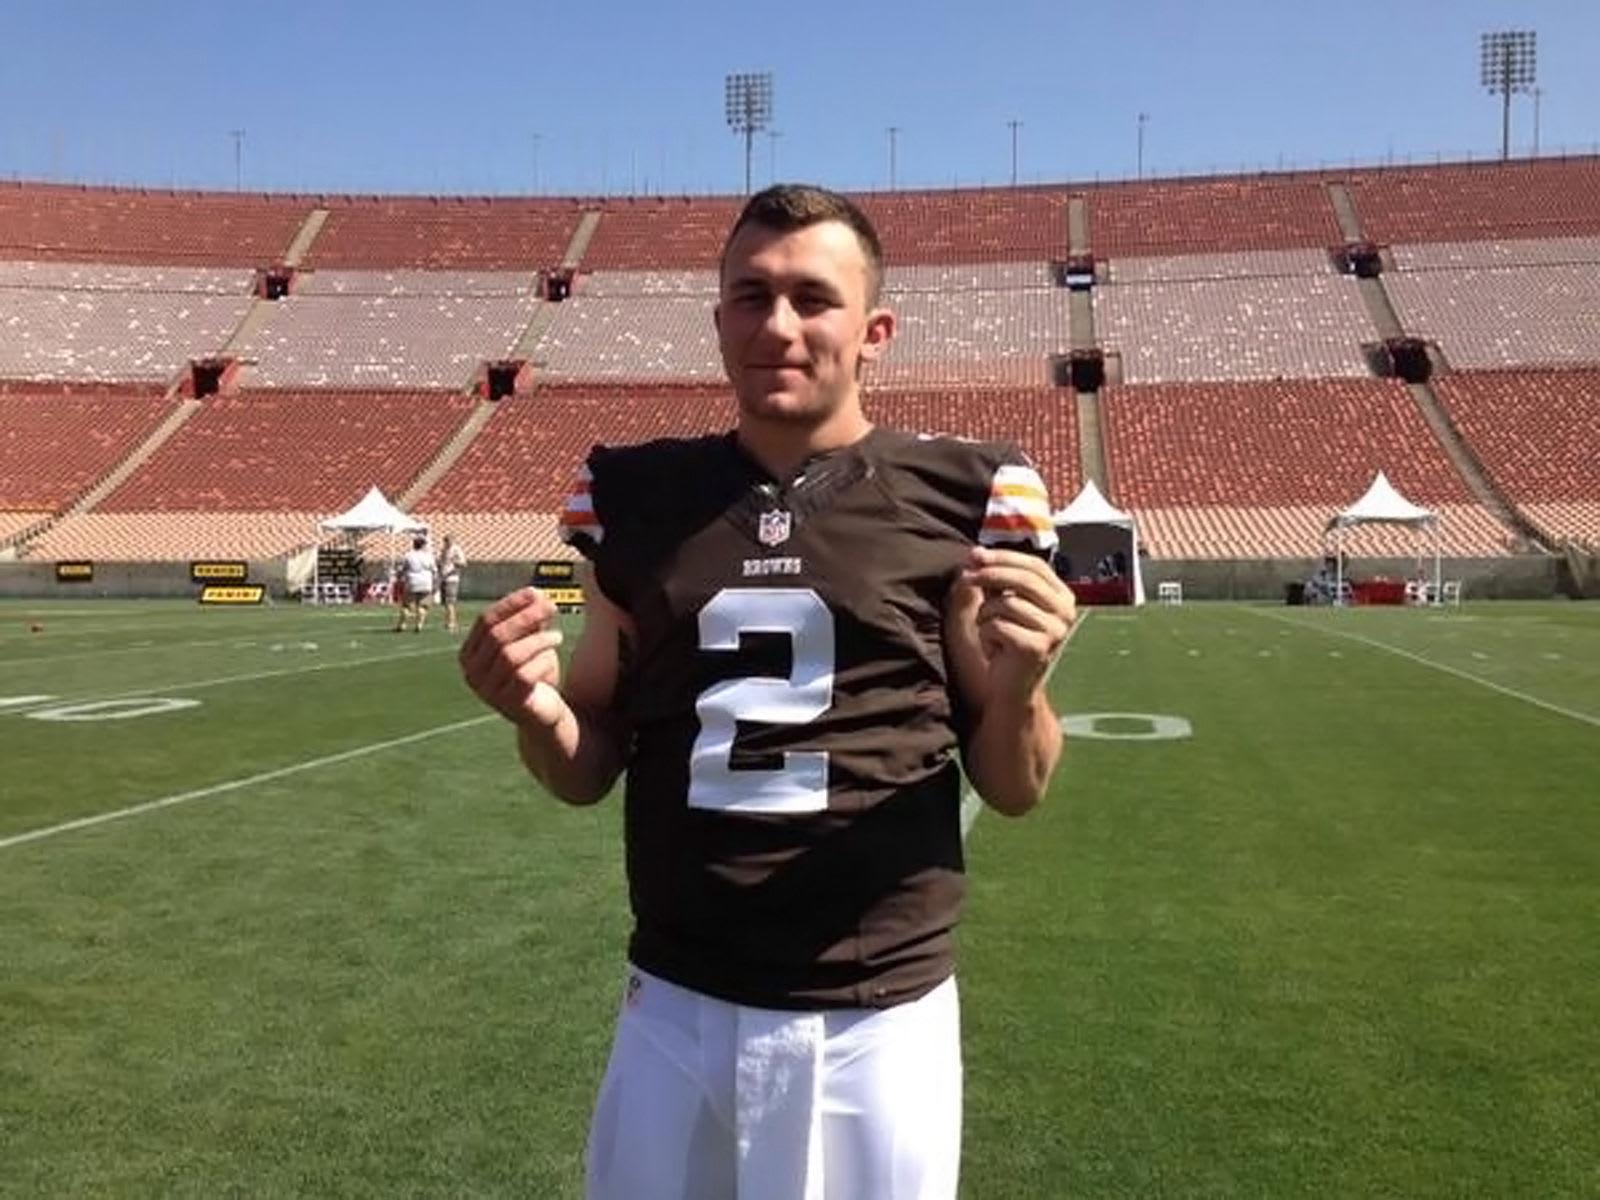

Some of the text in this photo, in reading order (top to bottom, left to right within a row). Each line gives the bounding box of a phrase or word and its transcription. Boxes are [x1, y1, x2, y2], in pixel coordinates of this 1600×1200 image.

[743, 558, 801, 576] BROWNS
[208, 590, 258, 599] PANINI
[687, 588, 835, 812] 2
